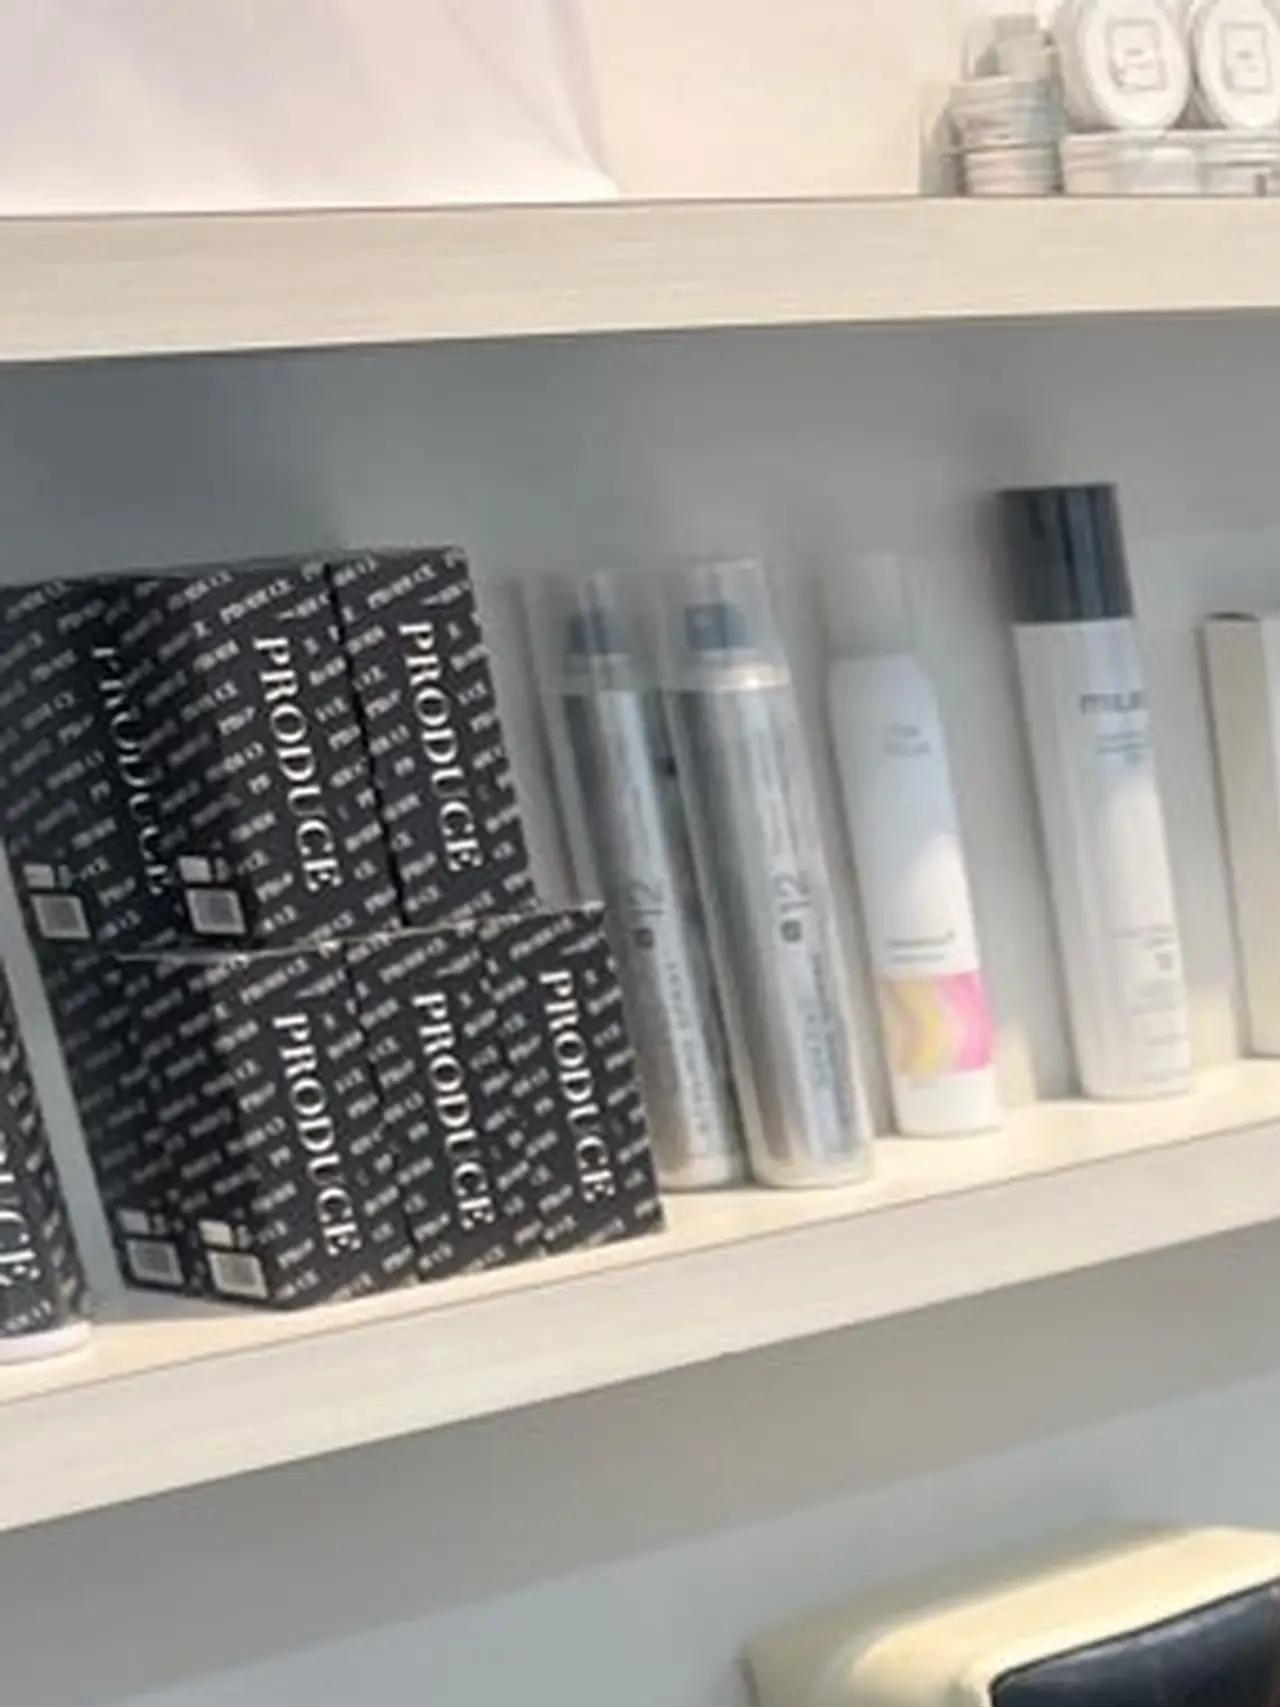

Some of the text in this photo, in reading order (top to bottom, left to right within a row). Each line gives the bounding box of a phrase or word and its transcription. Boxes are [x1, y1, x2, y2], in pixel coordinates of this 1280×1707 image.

[252, 637, 342, 892] PRODUCE
[399, 622, 485, 872] PRODUCE
[272, 1011, 363, 1258] PRODUCE
[411, 991, 497, 1232] PRODUCE
[539, 969, 617, 1204] PRODUCE
